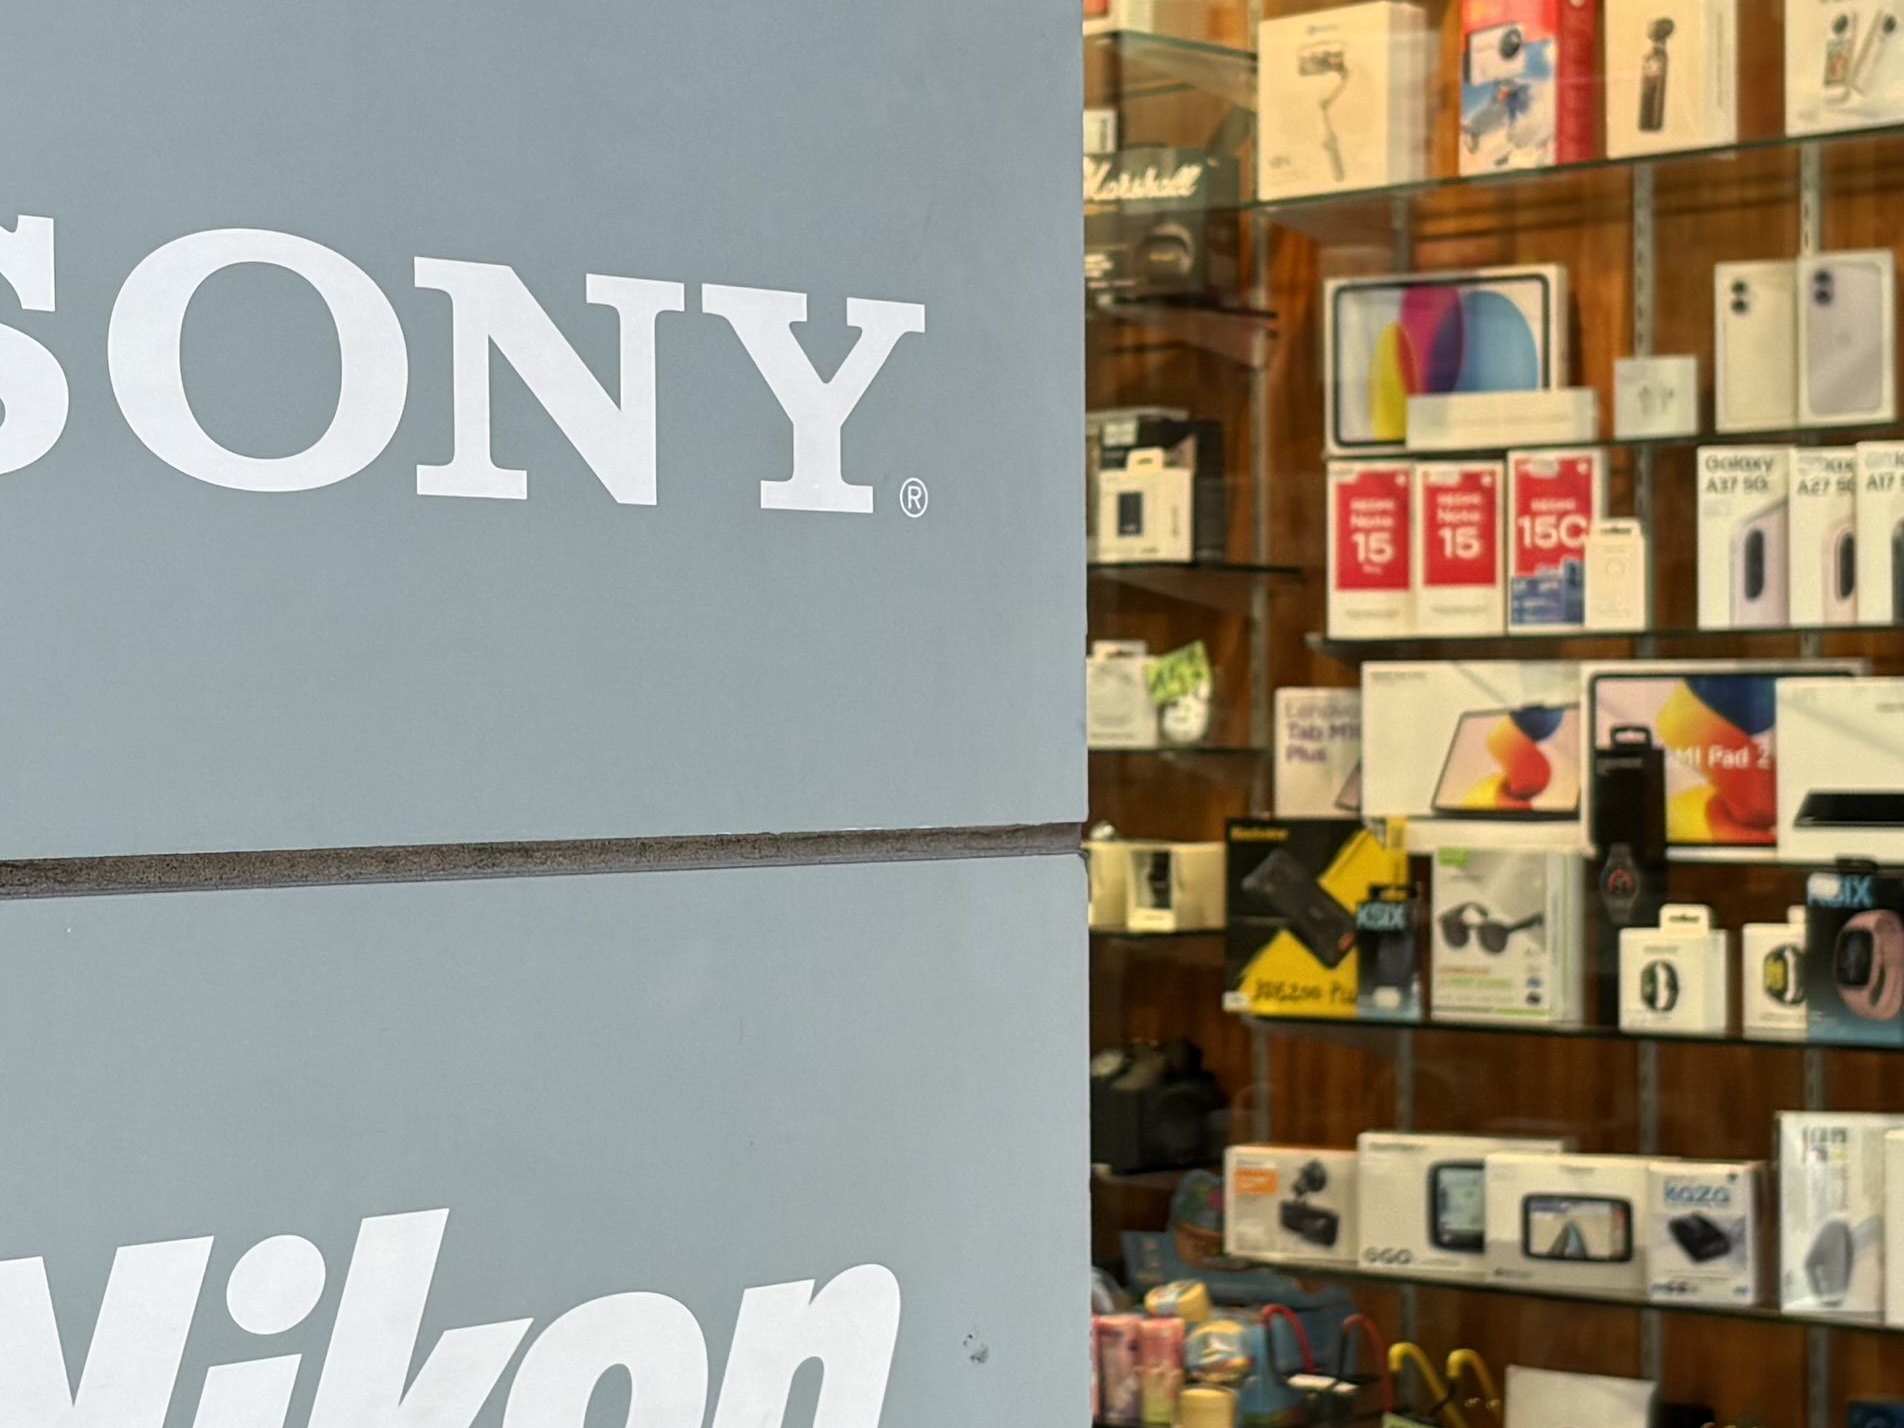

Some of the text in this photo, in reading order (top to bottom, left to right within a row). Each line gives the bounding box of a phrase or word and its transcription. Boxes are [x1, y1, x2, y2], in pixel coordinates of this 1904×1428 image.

[1705, 454, 1775, 473] Galaxy
[1352, 532, 1396, 564] 15
[1438, 526, 1483, 560] 15
[1517, 514, 1589, 550] 15C
[1708, 745, 1750, 770] Pad
[1758, 742, 1772, 770] 2
